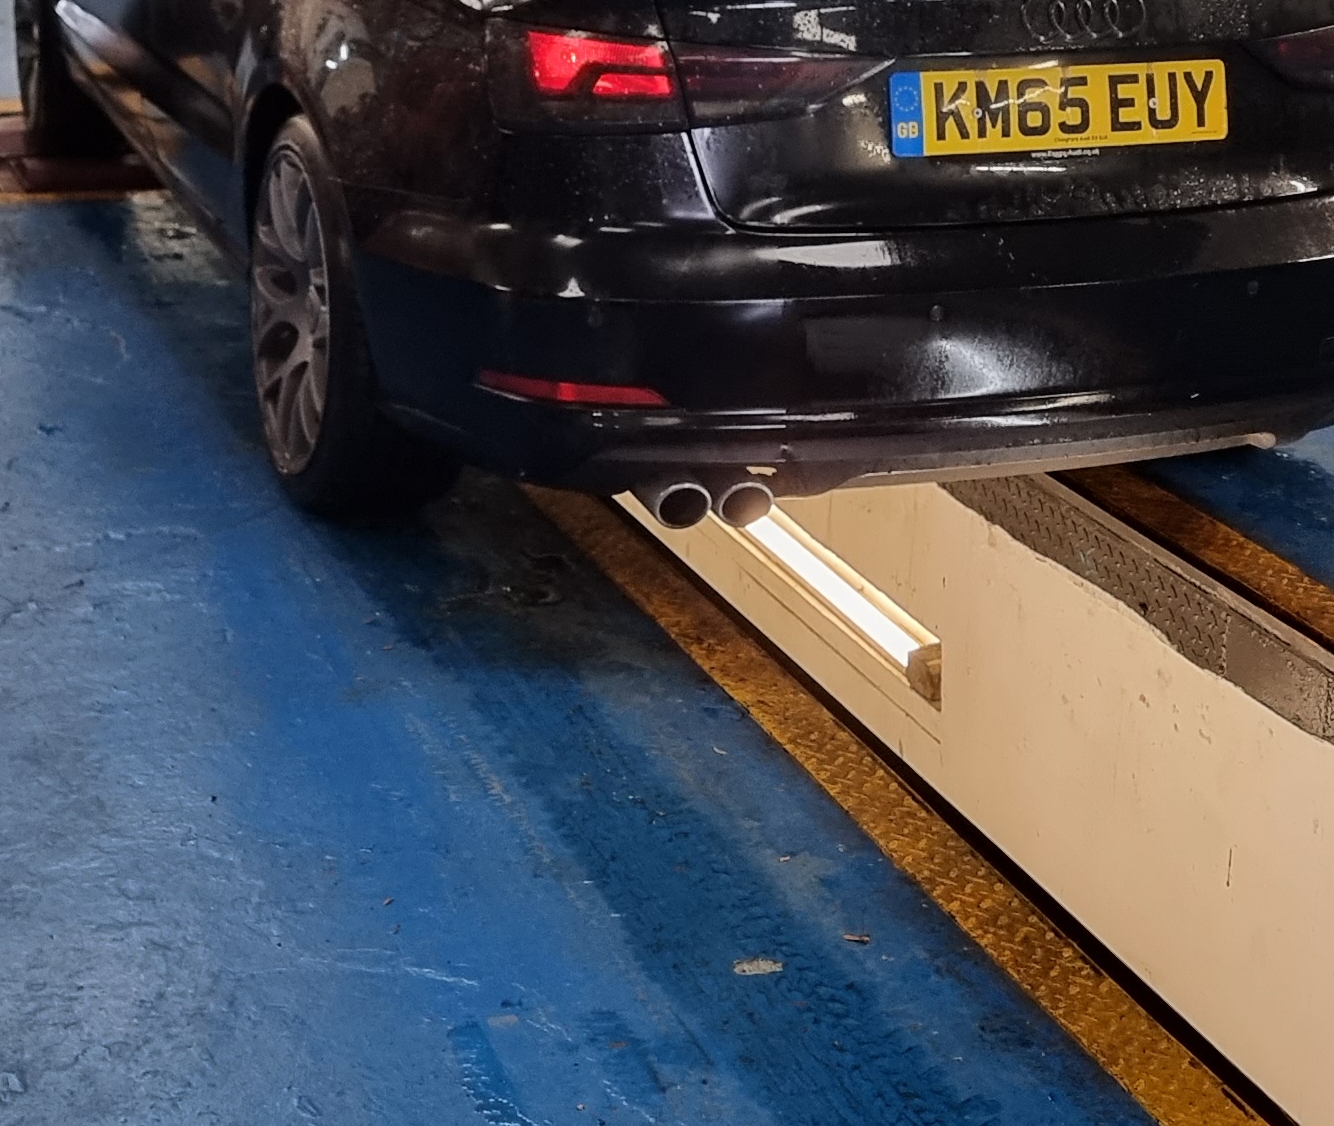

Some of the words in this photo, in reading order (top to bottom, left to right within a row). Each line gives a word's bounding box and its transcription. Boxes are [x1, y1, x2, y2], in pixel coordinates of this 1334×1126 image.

[933, 76, 1090, 142] KM65
[1107, 70, 1215, 134] EUY
[896, 121, 918, 139] GB
